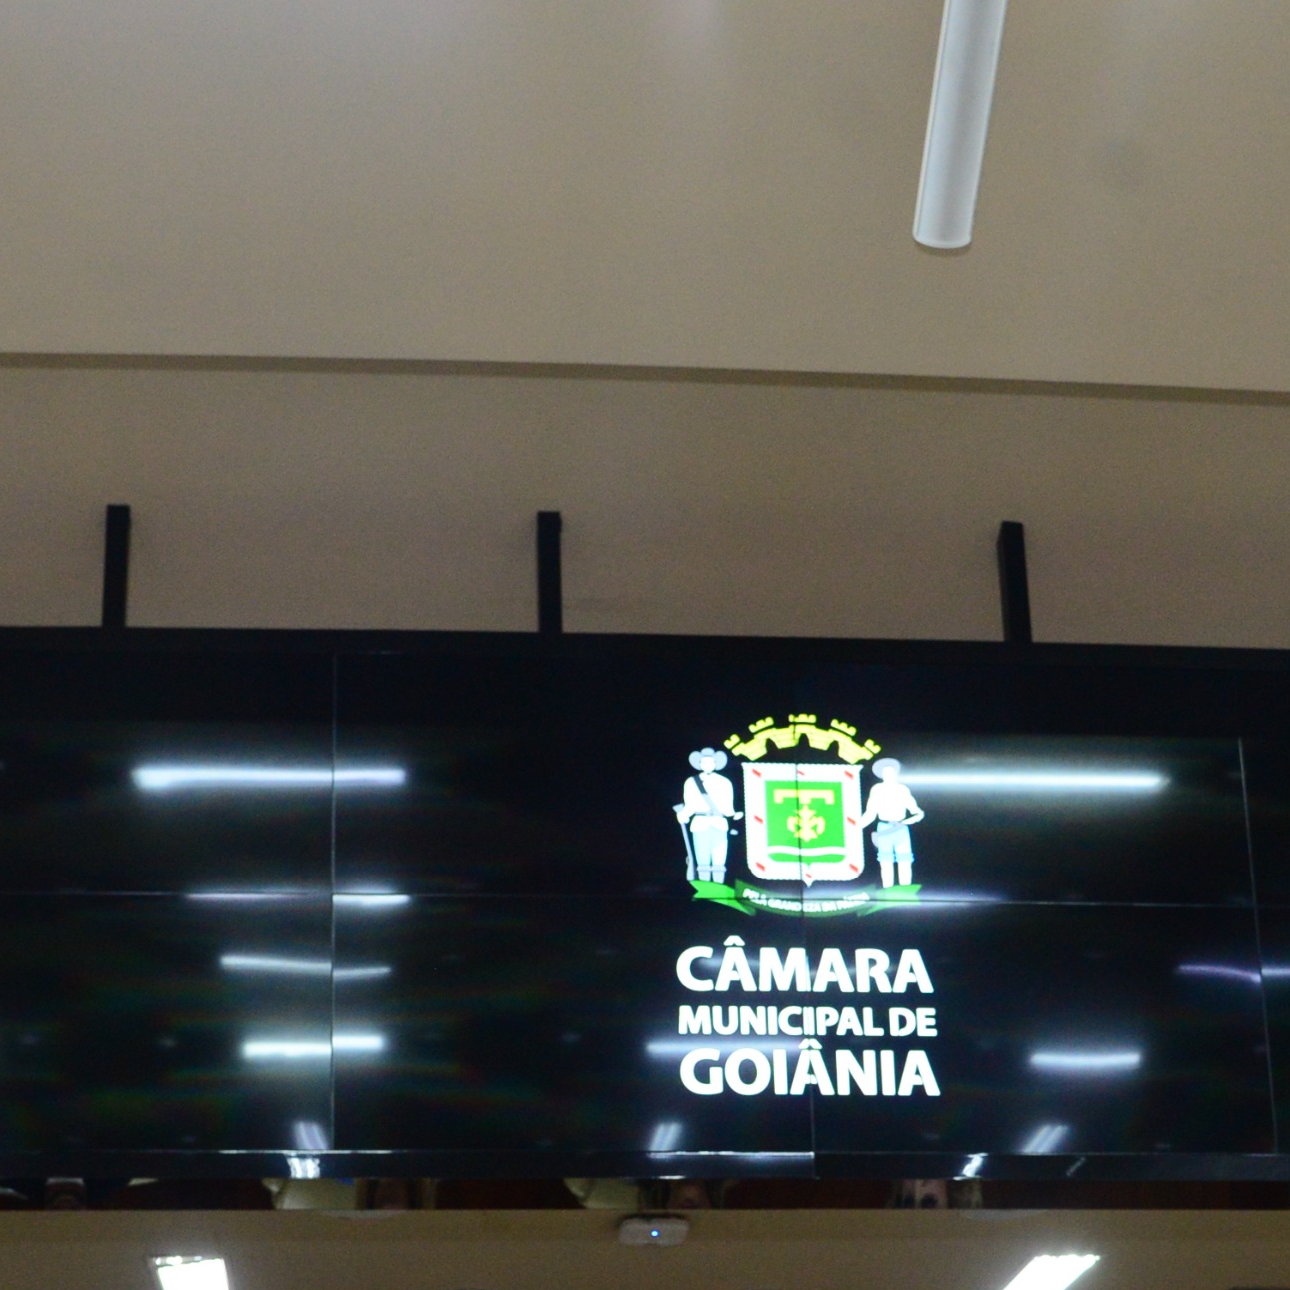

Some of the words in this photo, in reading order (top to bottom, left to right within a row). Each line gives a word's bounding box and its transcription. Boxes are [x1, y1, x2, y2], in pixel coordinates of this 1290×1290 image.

[675, 934, 934, 993] CÂMARA
[678, 1005, 883, 1036] MUNICIPAL
[889, 1008, 938, 1037] DE
[679, 1037, 940, 1096] GOIÂNIA
